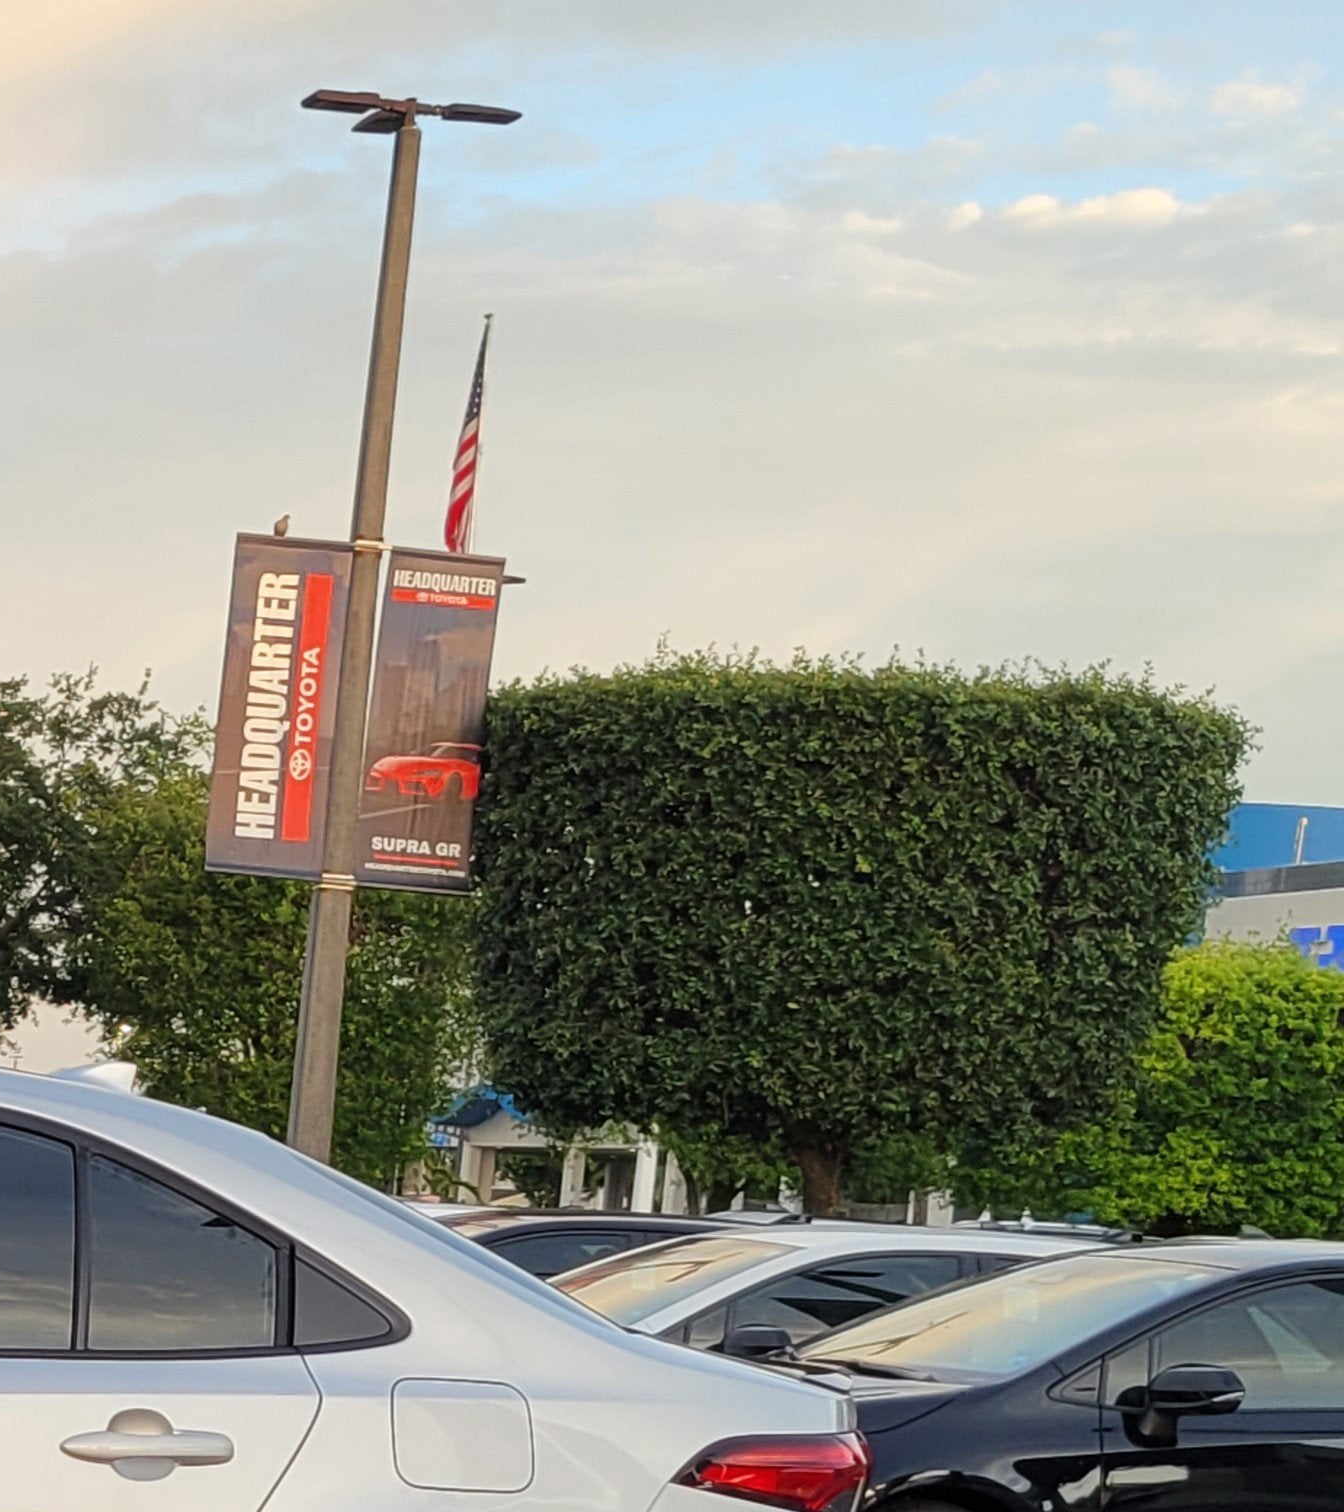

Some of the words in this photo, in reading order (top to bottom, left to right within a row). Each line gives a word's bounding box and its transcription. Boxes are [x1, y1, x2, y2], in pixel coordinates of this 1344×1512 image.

[393, 569, 496, 596] HEADQUARTER
[235, 572, 300, 840] HEADQUARTER
[294, 647, 321, 746] TOYOTA
[371, 836, 432, 855] SUPRA
[435, 842, 462, 858] GR
